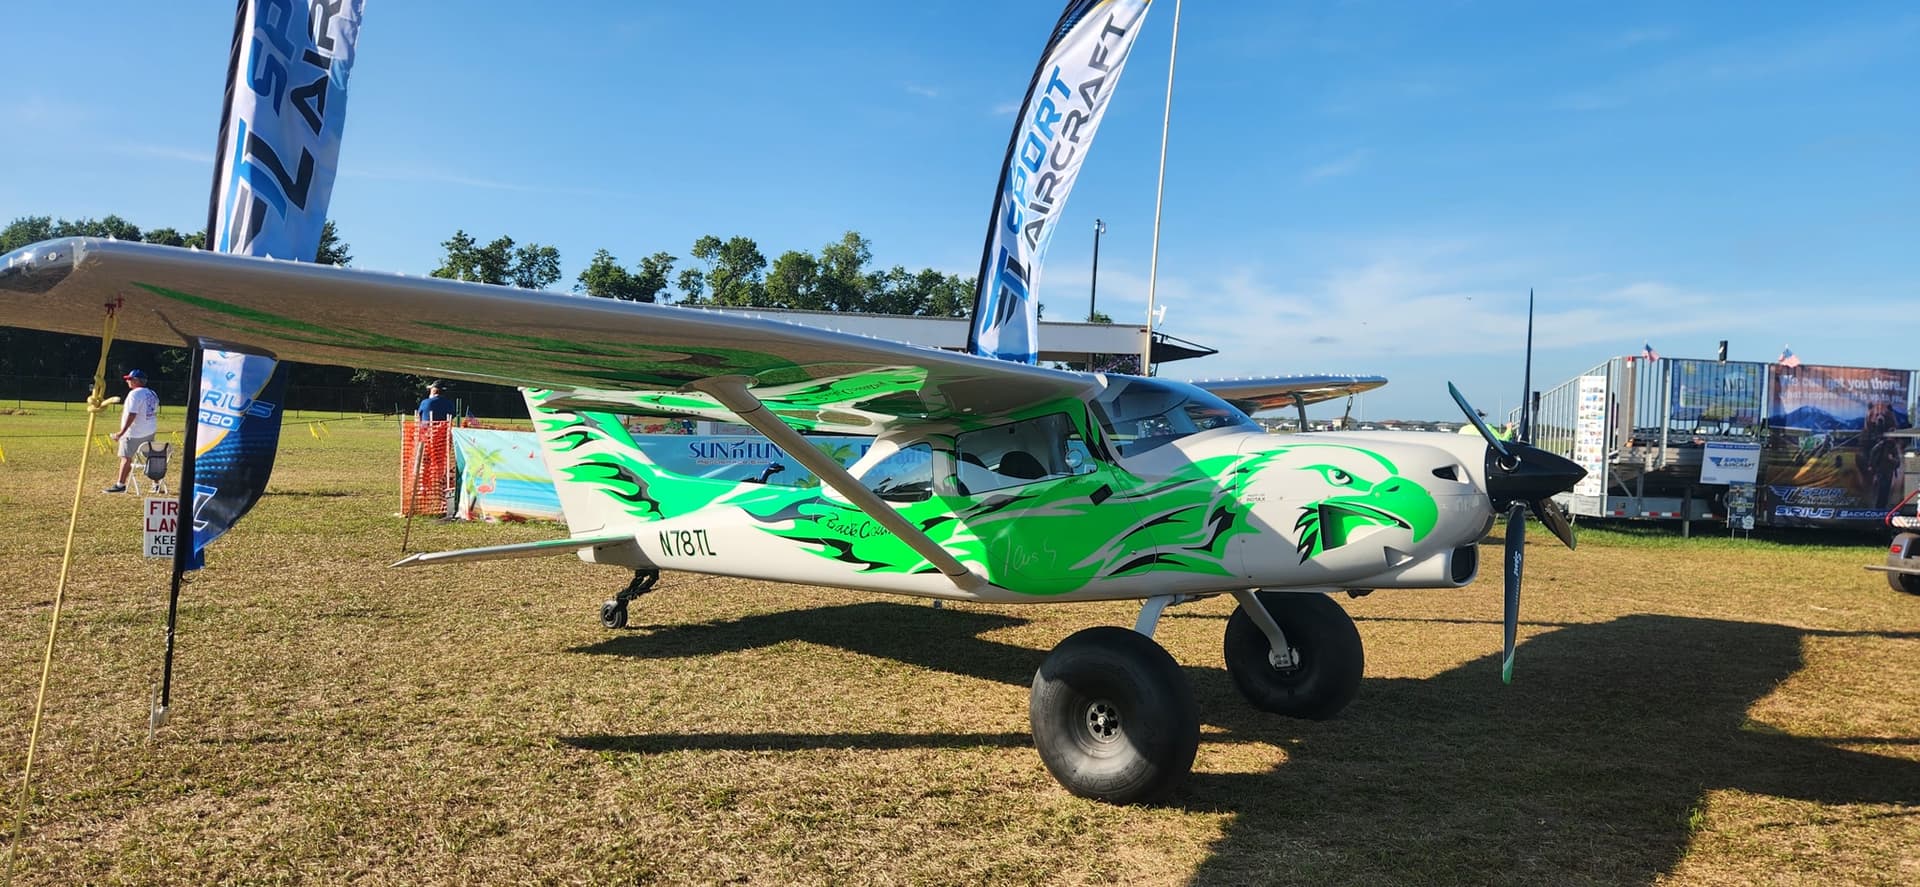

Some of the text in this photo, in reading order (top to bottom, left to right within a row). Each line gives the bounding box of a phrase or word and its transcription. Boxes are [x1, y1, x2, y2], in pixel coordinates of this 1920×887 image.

[1024, 12, 1127, 253] AIRCRAFT
[1006, 64, 1072, 236] SPORT
[1847, 378, 1868, 391] you
[201, 388, 276, 418] RIUS
[200, 410, 234, 427] RBO
[150, 501, 179, 516] FIR
[1774, 504, 1834, 519] SIRIUS
[146, 518, 177, 533] LAN
[154, 535, 176, 545] KEE
[659, 528, 717, 557] N78TL
[151, 545, 175, 556] CLE
